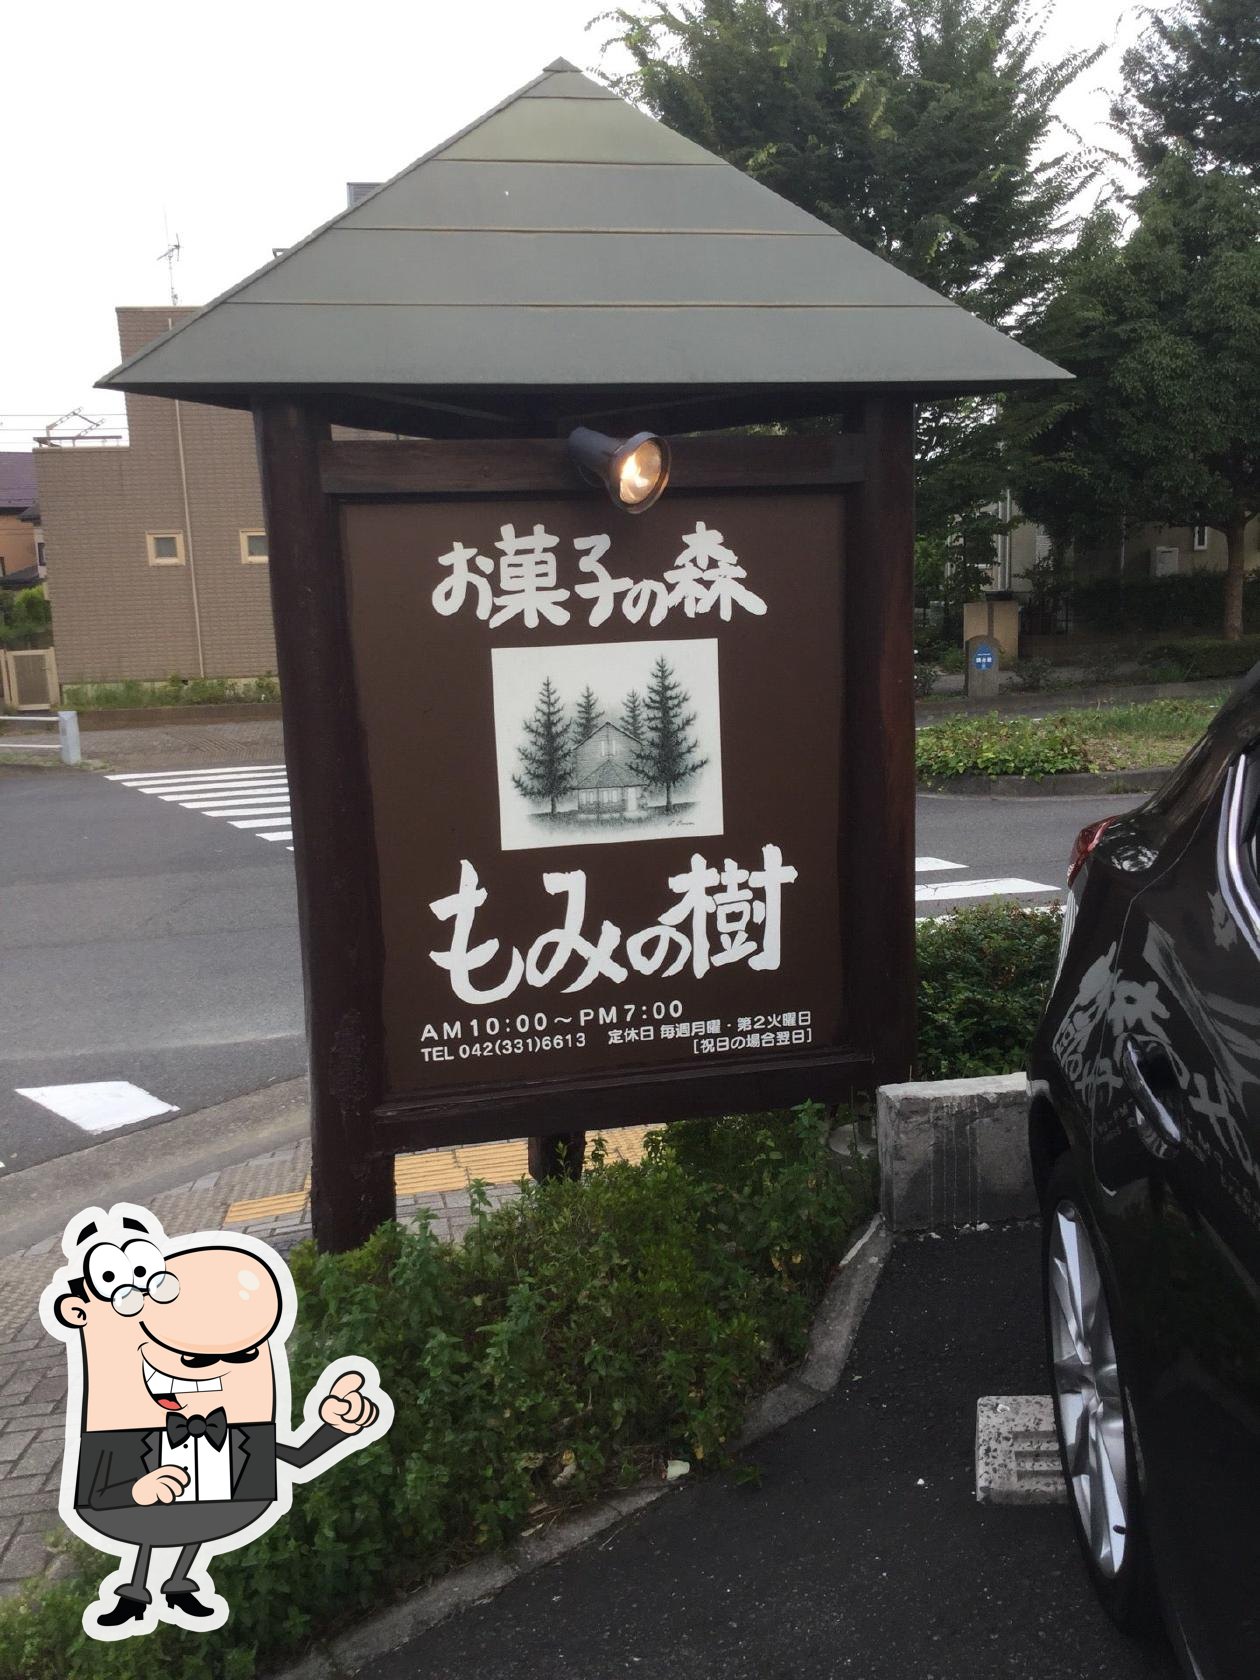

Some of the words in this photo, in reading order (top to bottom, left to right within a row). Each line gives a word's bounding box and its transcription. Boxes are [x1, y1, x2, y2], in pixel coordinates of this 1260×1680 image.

[432, 521, 767, 629] お菓子の森
[429, 843, 798, 1004] もみの樹
[421, 1045, 455, 1062] TEL
[459, 1033, 586, 1058] 042(331)6613
[608, 1026, 655, 1044] 定休日
